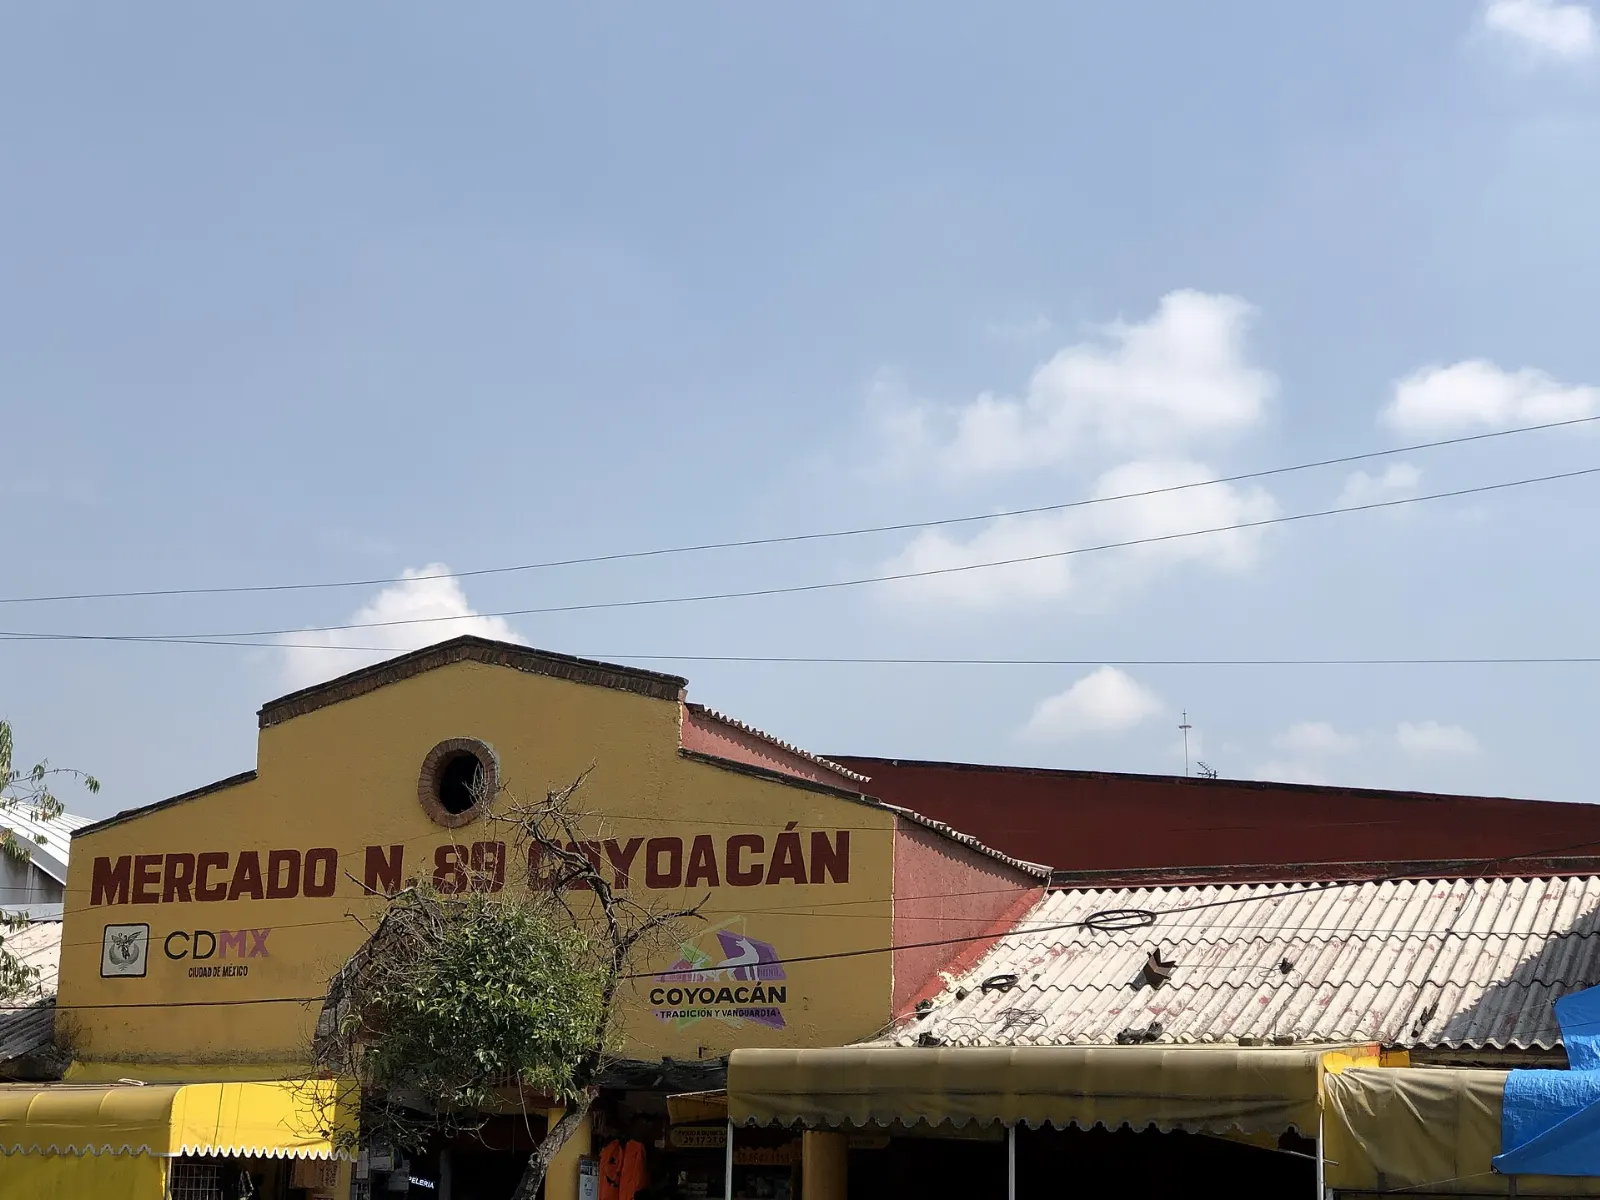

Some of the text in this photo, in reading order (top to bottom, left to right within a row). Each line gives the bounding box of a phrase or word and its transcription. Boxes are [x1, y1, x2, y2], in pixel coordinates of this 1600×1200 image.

[90, 847, 338, 906] MERCADO
[432, 841, 505, 894] 89
[527, 821, 850, 892] COYOACÁN
[164, 928, 271, 960] CDMX
[188, 963, 248, 978] CIUDAD DE MÉXICO
[649, 981, 787, 1005] COYOACÁN
[715, 1009, 720, 1017] Y
[722, 1008, 776, 1018] VANGUARDIA
